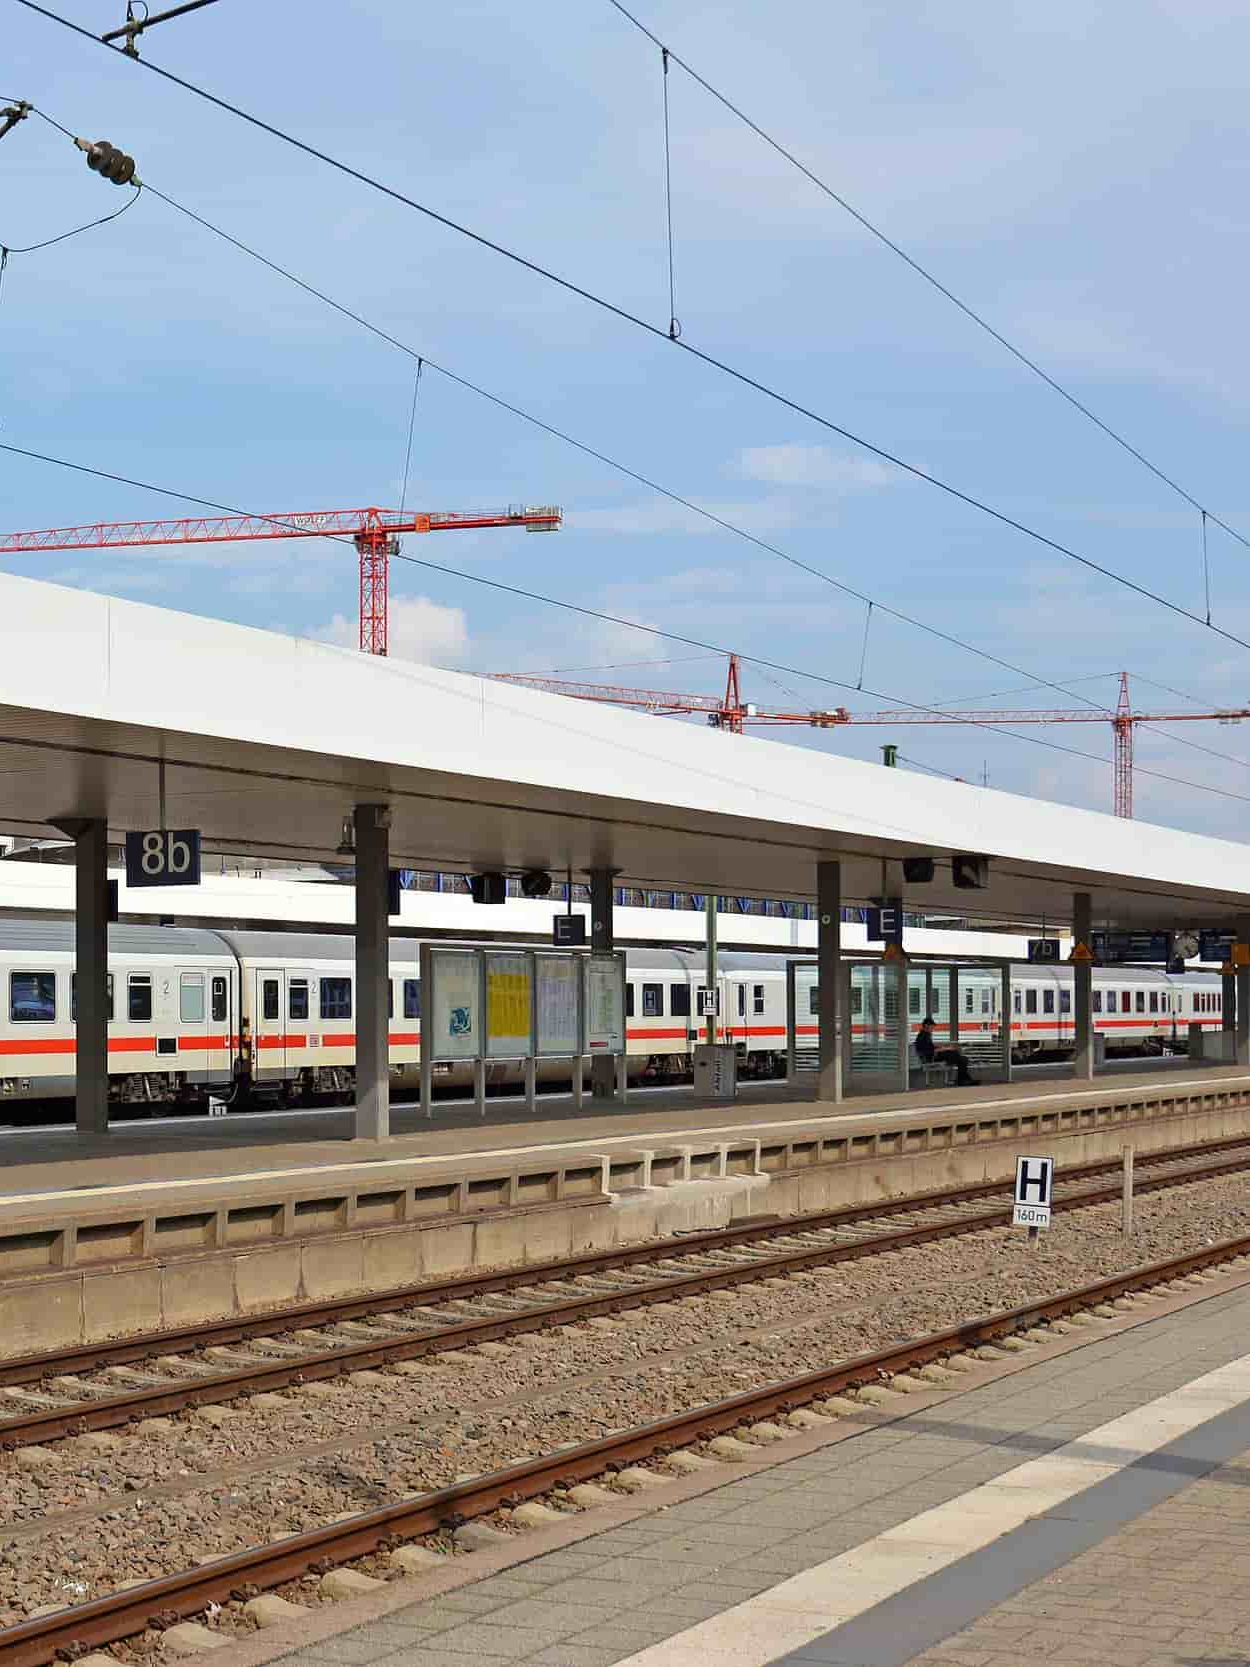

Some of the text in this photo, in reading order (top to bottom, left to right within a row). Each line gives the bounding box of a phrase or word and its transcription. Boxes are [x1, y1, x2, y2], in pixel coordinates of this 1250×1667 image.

[142, 832, 190, 874] 8b
[558, 917, 571, 939] E
[880, 909, 895, 932] E
[705, 992, 714, 1007] H
[1020, 1161, 1048, 1202] H
